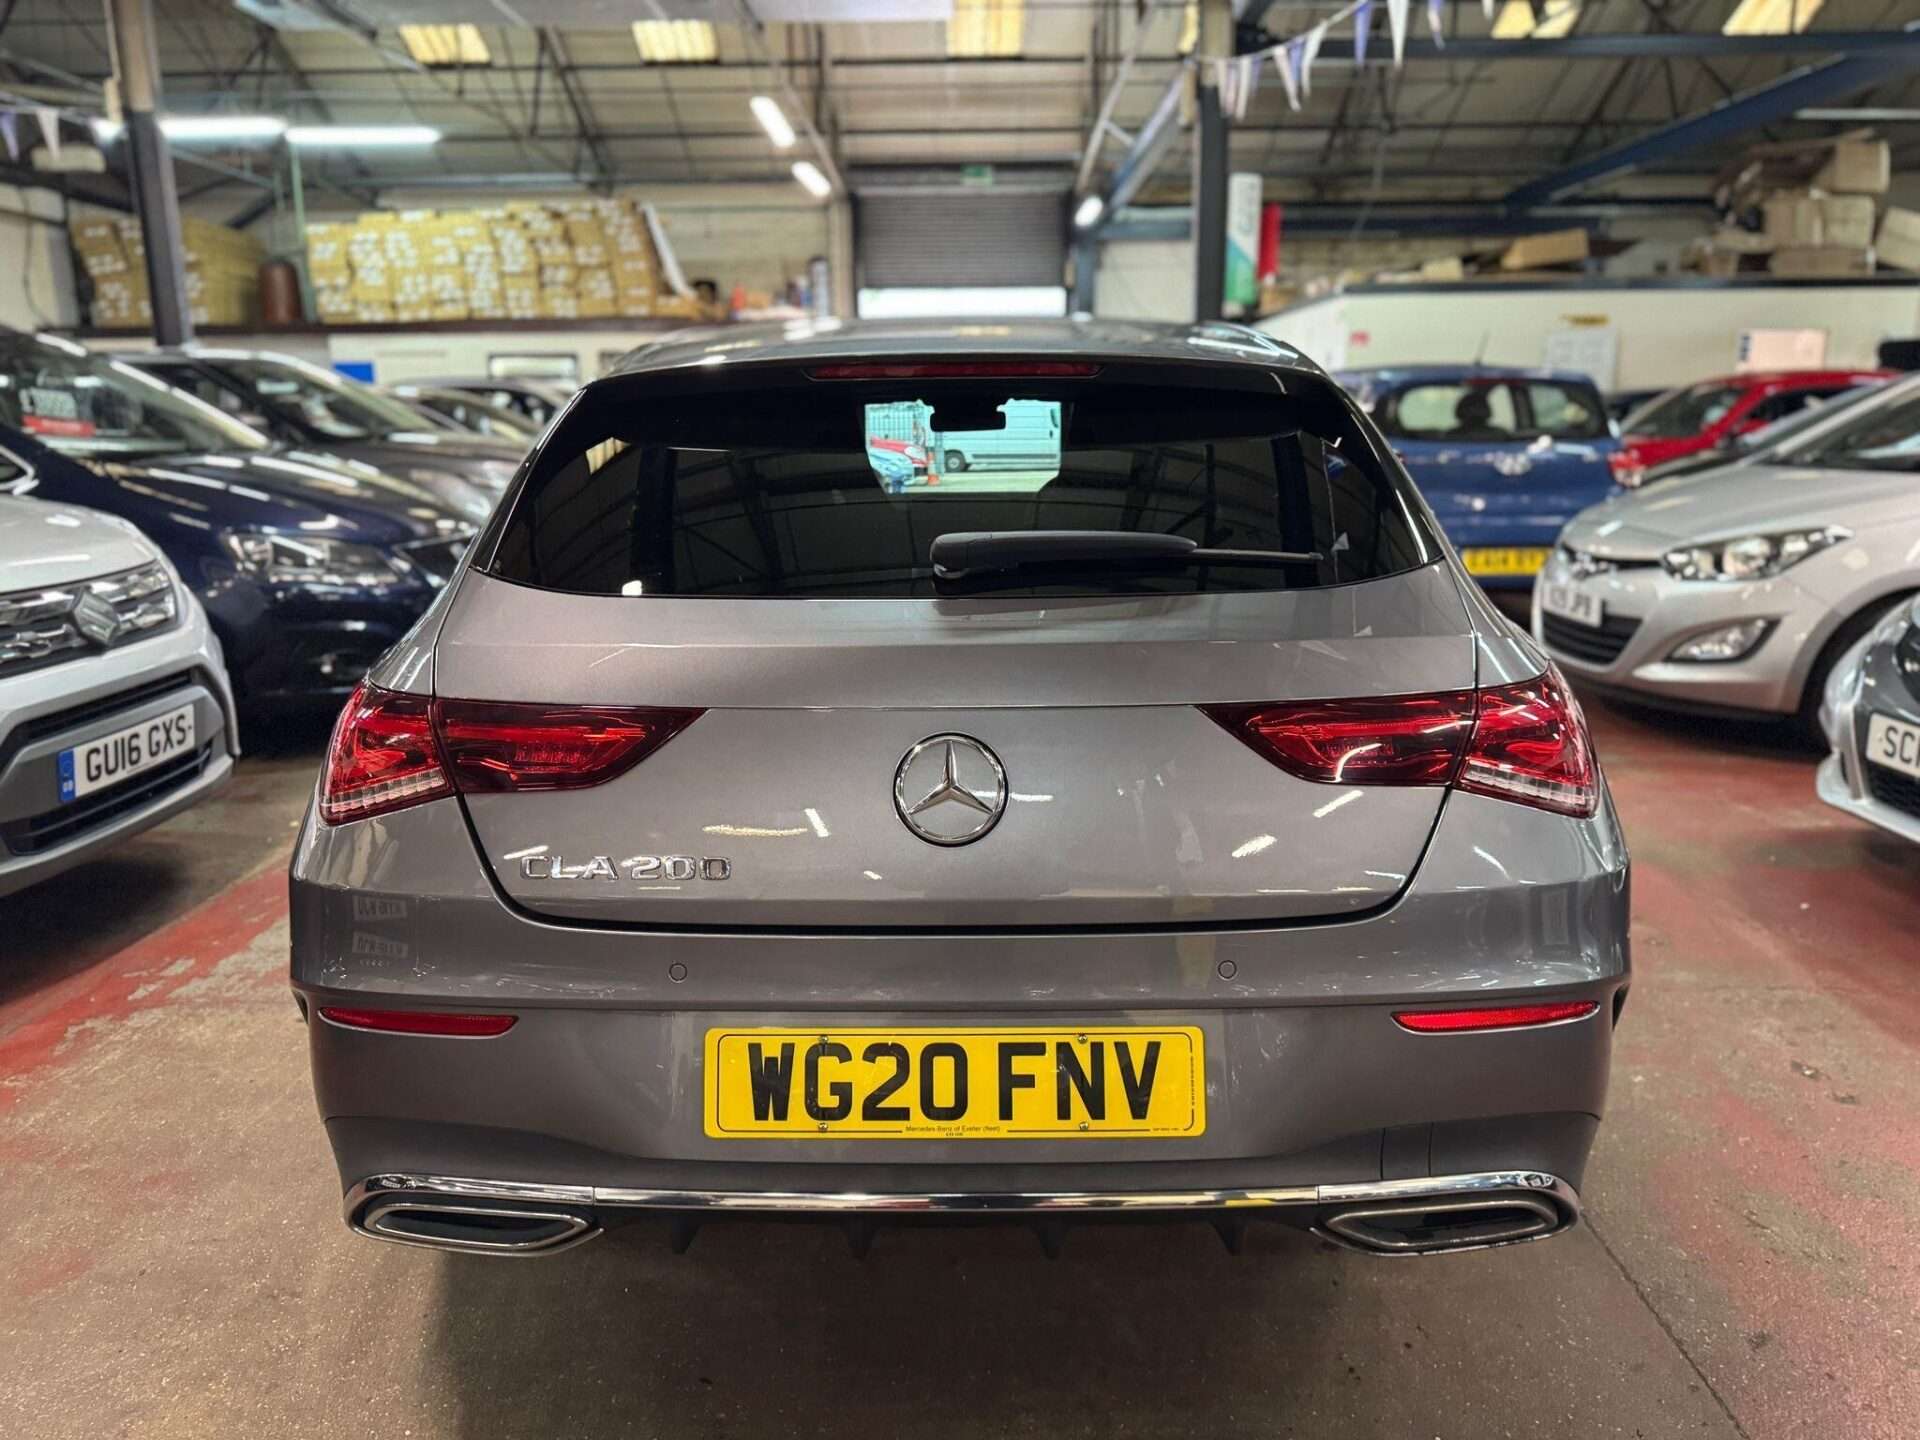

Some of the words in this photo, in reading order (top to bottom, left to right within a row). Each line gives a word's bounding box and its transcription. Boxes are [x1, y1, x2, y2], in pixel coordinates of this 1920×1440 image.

[86, 733, 141, 783] GU16
[148, 714, 187, 758] GXS
[520, 856, 619, 880] CLA
[630, 855, 731, 880] 200
[748, 1042, 968, 1121] WG20
[998, 1042, 1161, 1120] FNV
